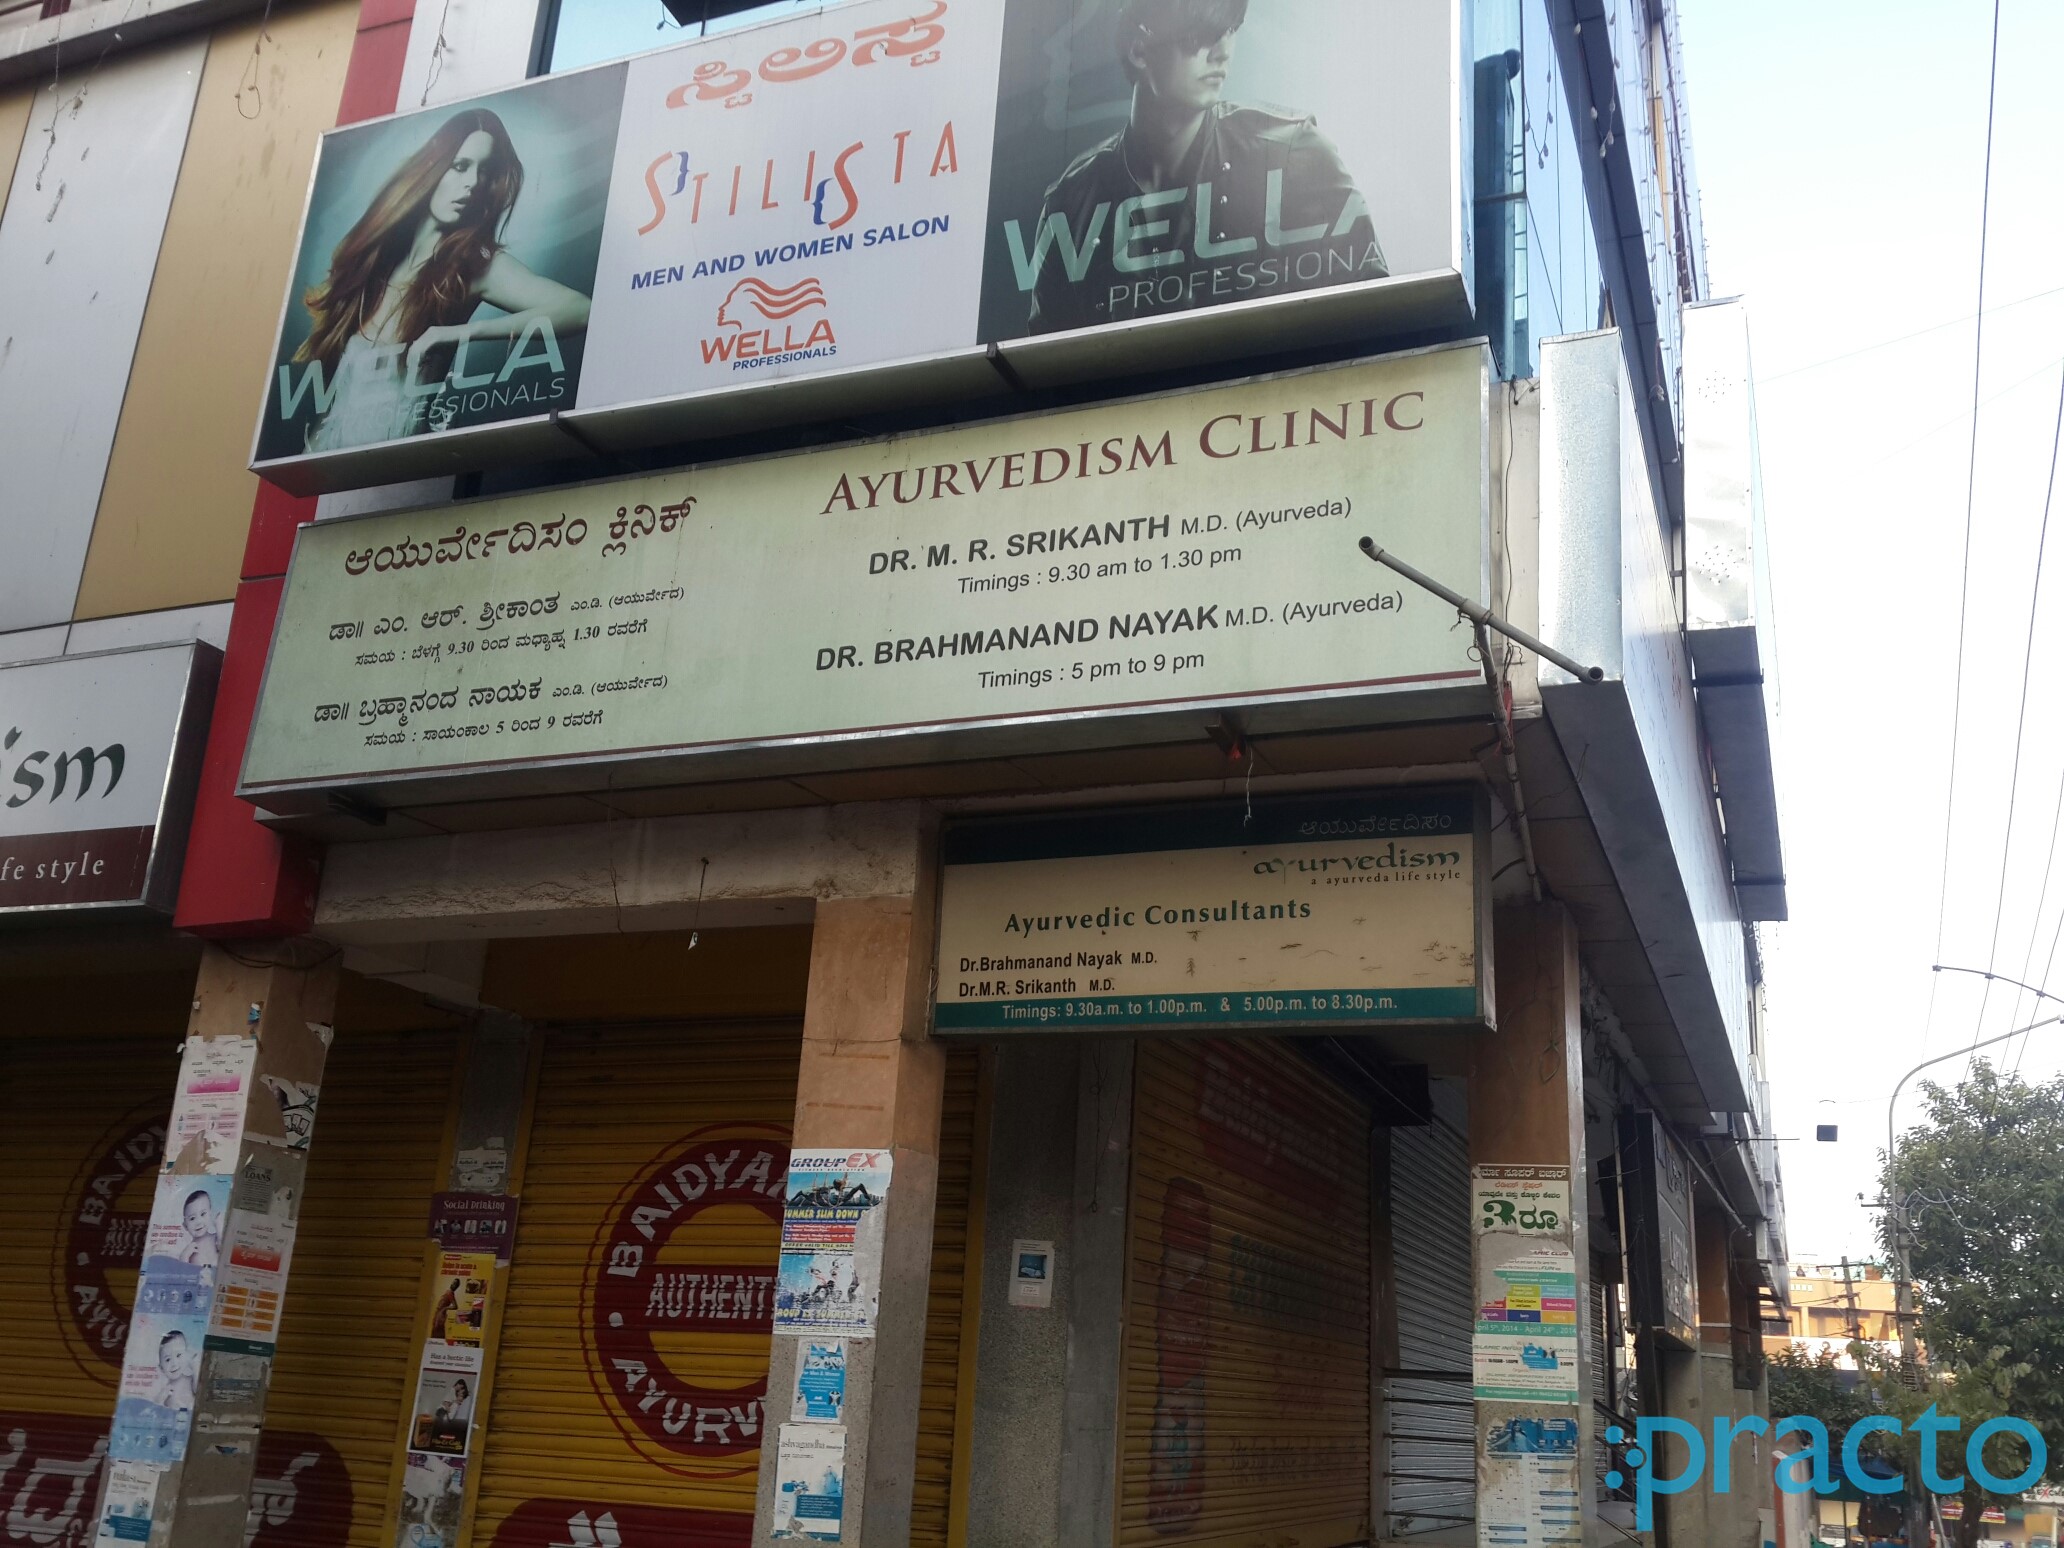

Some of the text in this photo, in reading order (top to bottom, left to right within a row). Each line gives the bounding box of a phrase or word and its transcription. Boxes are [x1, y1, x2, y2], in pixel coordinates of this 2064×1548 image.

[637, 121, 957, 237] STILISTA
[631, 215, 950, 290] MEN AND WOMEN SALON
[1108, 240, 1390, 313] PROFESSIONA
[701, 319, 836, 364] WELLA
[732, 345, 837, 371] PROFESSIONALS
[819, 391, 1425, 515] AYURVEDISM CLINIC
[601, 496, 697, 558] ಕ್ಲಿನಿಕ್
[869, 497, 1352, 575] DR. M. R. SRIKANTH M.D. (Ayurveda)
[958, 569, 1030, 594] Timings
[1048, 561, 1091, 584] 9.30
[1096, 560, 1128, 577] am
[1133, 555, 1153, 573] to
[1161, 551, 1202, 570] 1.30
[1209, 547, 1242, 567] pm
[447, 639, 475, 656] 9.30
[481, 633, 510, 652] ರಿಂದ
[572, 625, 600, 643] 1.30
[816, 592, 1404, 672] DR. BRAHMANAND NAYAK M.D. (Ayurveda)
[978, 666, 1053, 691] Timings
[1071, 660, 1084, 680] 5
[1088, 661, 1121, 682] pm
[1128, 655, 1147, 673] to
[1154, 651, 1167, 671] 9
[1172, 650, 1205, 675] pm
[467, 677, 543, 710] ನಾಯಕ
[495, 718, 505, 735] 5
[511, 714, 540, 733] ರಿಂದ
[546, 713, 556, 730] 9
[36, 852, 105, 884] style
[1253, 842, 1461, 884] ayurvedism
[1311, 869, 1461, 886] a ayurveda life style
[1004, 899, 1312, 937] Ayurvedic Consultants
[1077, 949, 1122, 970] Nayak
[1131, 951, 1158, 964] M.D.
[1015, 976, 1076, 994] Srikanth
[1089, 978, 1115, 991] M.D.
[1002, 993, 1398, 1023] Timings: 9.30a.m. to 1.00p.m. & 5.00p.m. to 8.30p.m.
[245, 1171, 271, 1183] LOANS
[443, 1200, 506, 1212] Social Drinking
[835, 1209, 859, 1219] DOWN
[645, 1273, 777, 1319] AUTHENT
[1502, 1325, 1518, 1333] 2014
[1524, 1325, 1541, 1334] April
[1560, 1327, 1577, 1335] 2014
